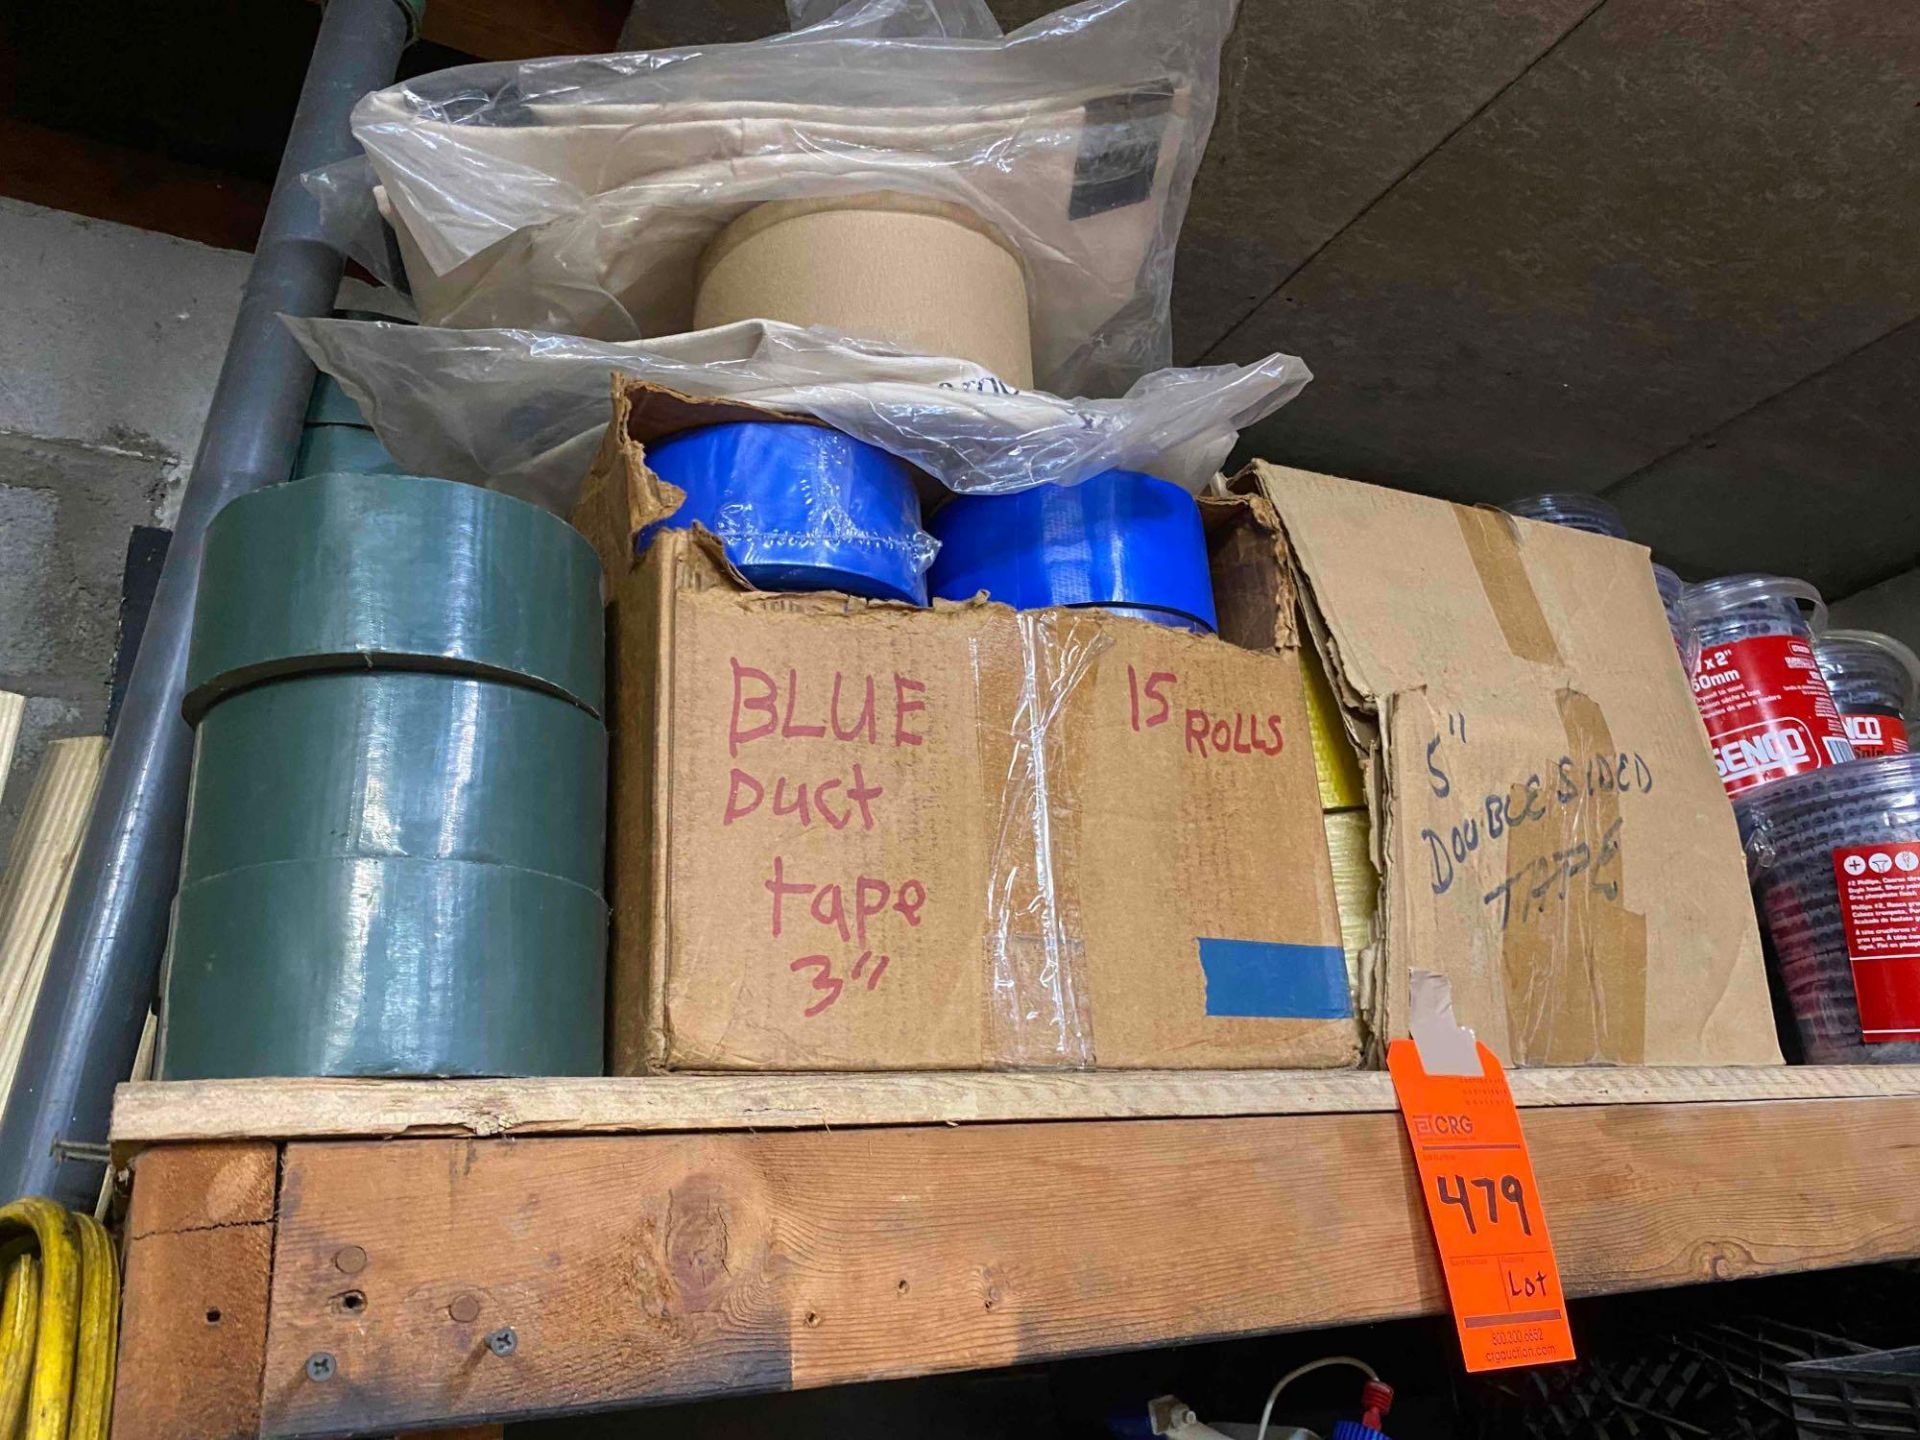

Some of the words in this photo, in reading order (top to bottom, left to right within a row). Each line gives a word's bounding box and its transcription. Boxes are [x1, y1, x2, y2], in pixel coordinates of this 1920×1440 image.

[729, 656, 926, 758] BLUE
[1128, 664, 1177, 732] 15
[1185, 708, 1284, 759] ROLLS
[1421, 773, 1546, 894] DOUBLE
[1557, 752, 1653, 804] SIDED
[764, 855, 926, 948] tape
[1484, 817, 1623, 930] TAPE
[790, 950, 889, 1017] 3"
[1435, 1114, 1473, 1135] CRG
[1437, 1175, 1532, 1236] 479
[1508, 1270, 1546, 1297] Lot
